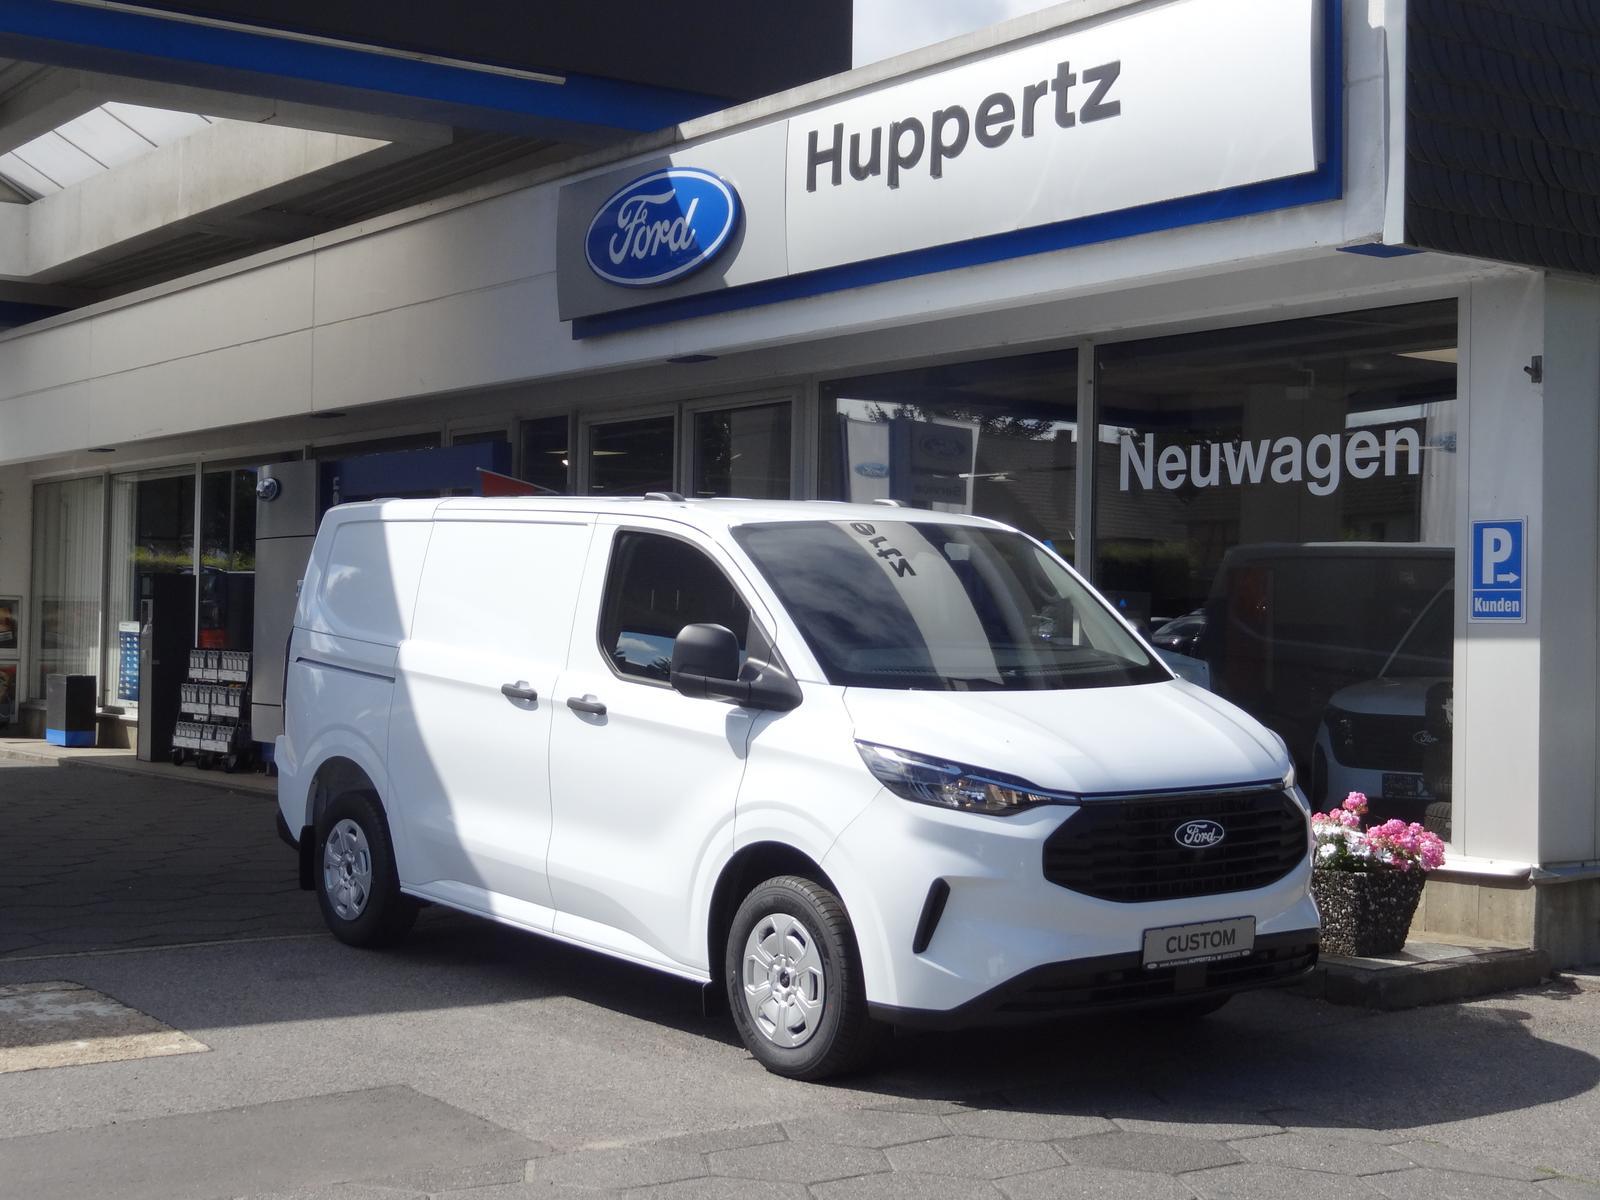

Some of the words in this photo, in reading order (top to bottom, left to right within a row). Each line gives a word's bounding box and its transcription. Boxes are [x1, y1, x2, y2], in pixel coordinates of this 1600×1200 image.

[807, 60, 1121, 192] Huppertz
[608, 188, 699, 264] Ford
[1119, 426, 1420, 496] Neuwagen
[1482, 527, 1513, 585] P
[1474, 597, 1520, 613] Kunden
[1184, 823, 1218, 844] Ford
[1165, 928, 1236, 954] CUSTOM
